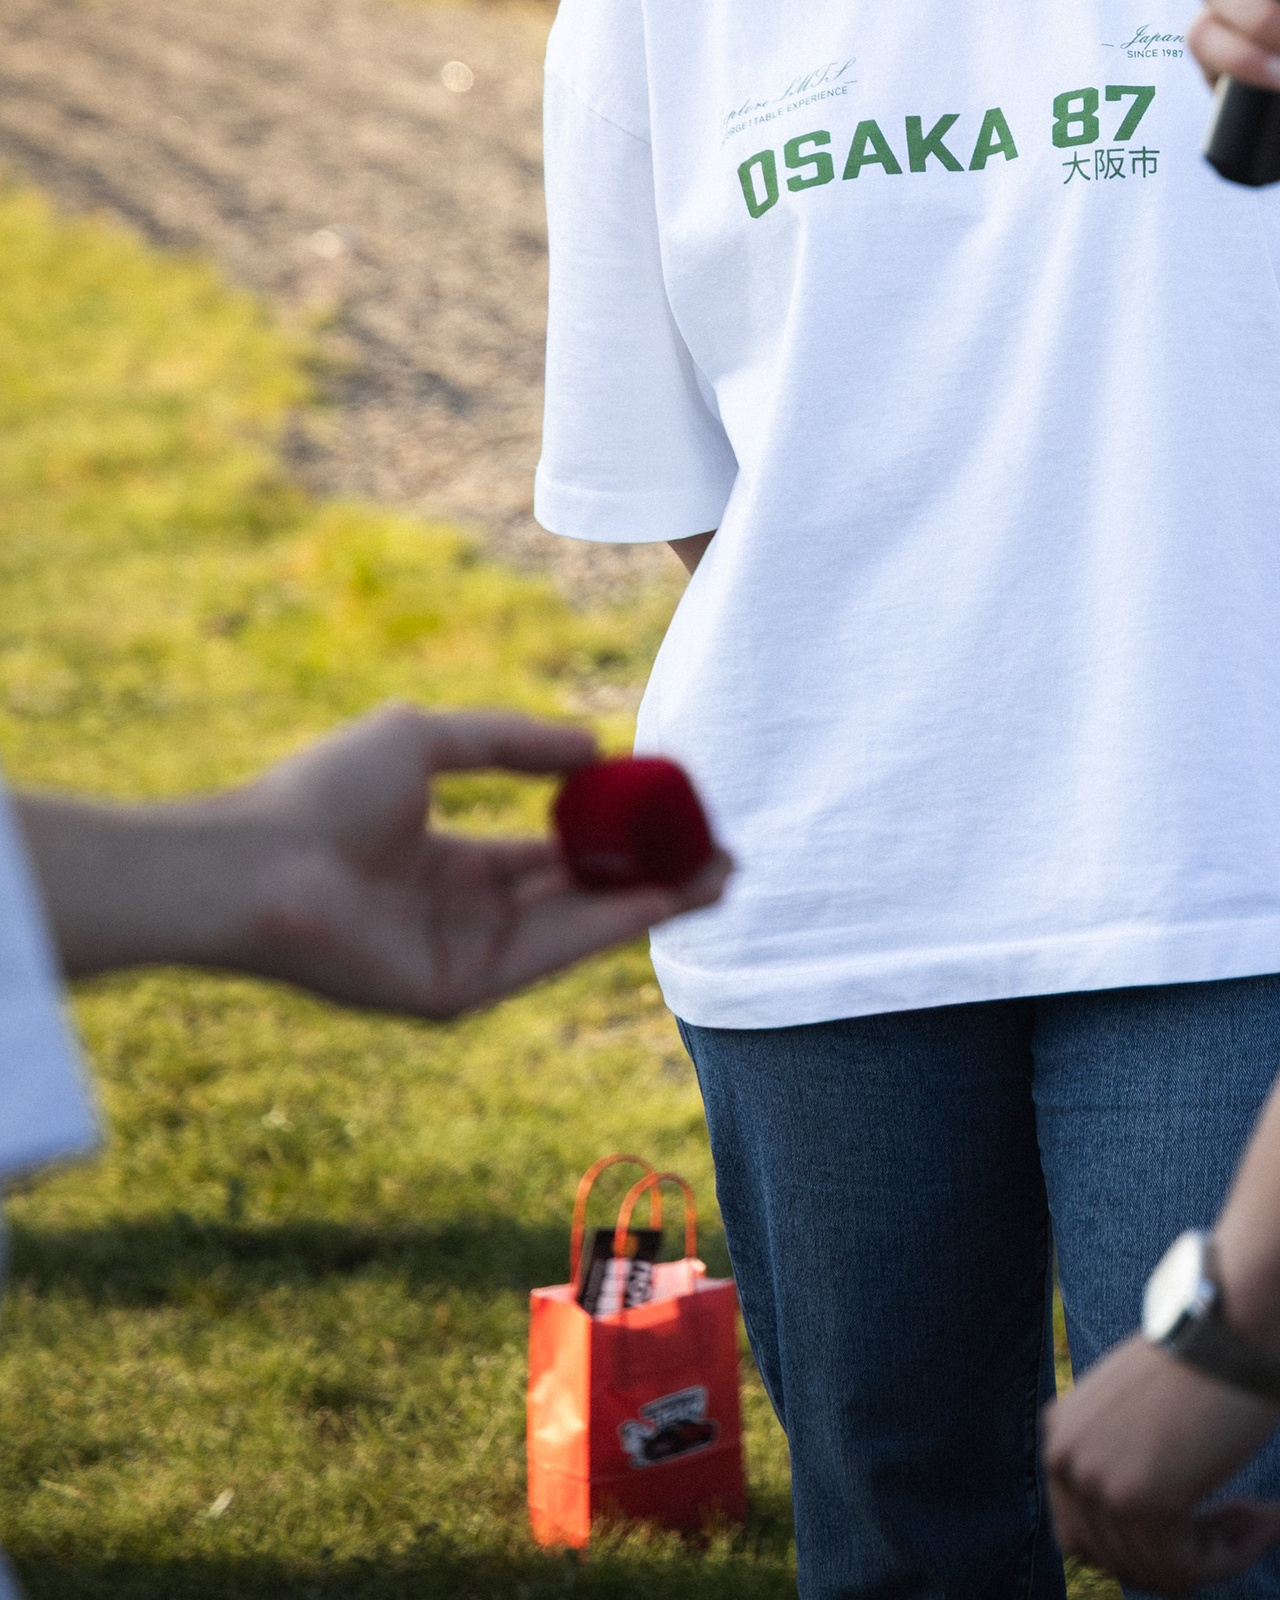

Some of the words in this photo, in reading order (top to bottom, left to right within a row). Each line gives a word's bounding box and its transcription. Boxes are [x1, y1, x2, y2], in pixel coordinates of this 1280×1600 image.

[1120, 23, 1185, 50] Japan
[1126, 48, 1159, 59] SINCE
[1161, 48, 1184, 59] 1987
[786, 85, 848, 112] EXPERIENCE
[736, 106, 1019, 220] OSAKA
[1051, 84, 1157, 149] 87
[1061, 145, 1162, 186] 大阪市
